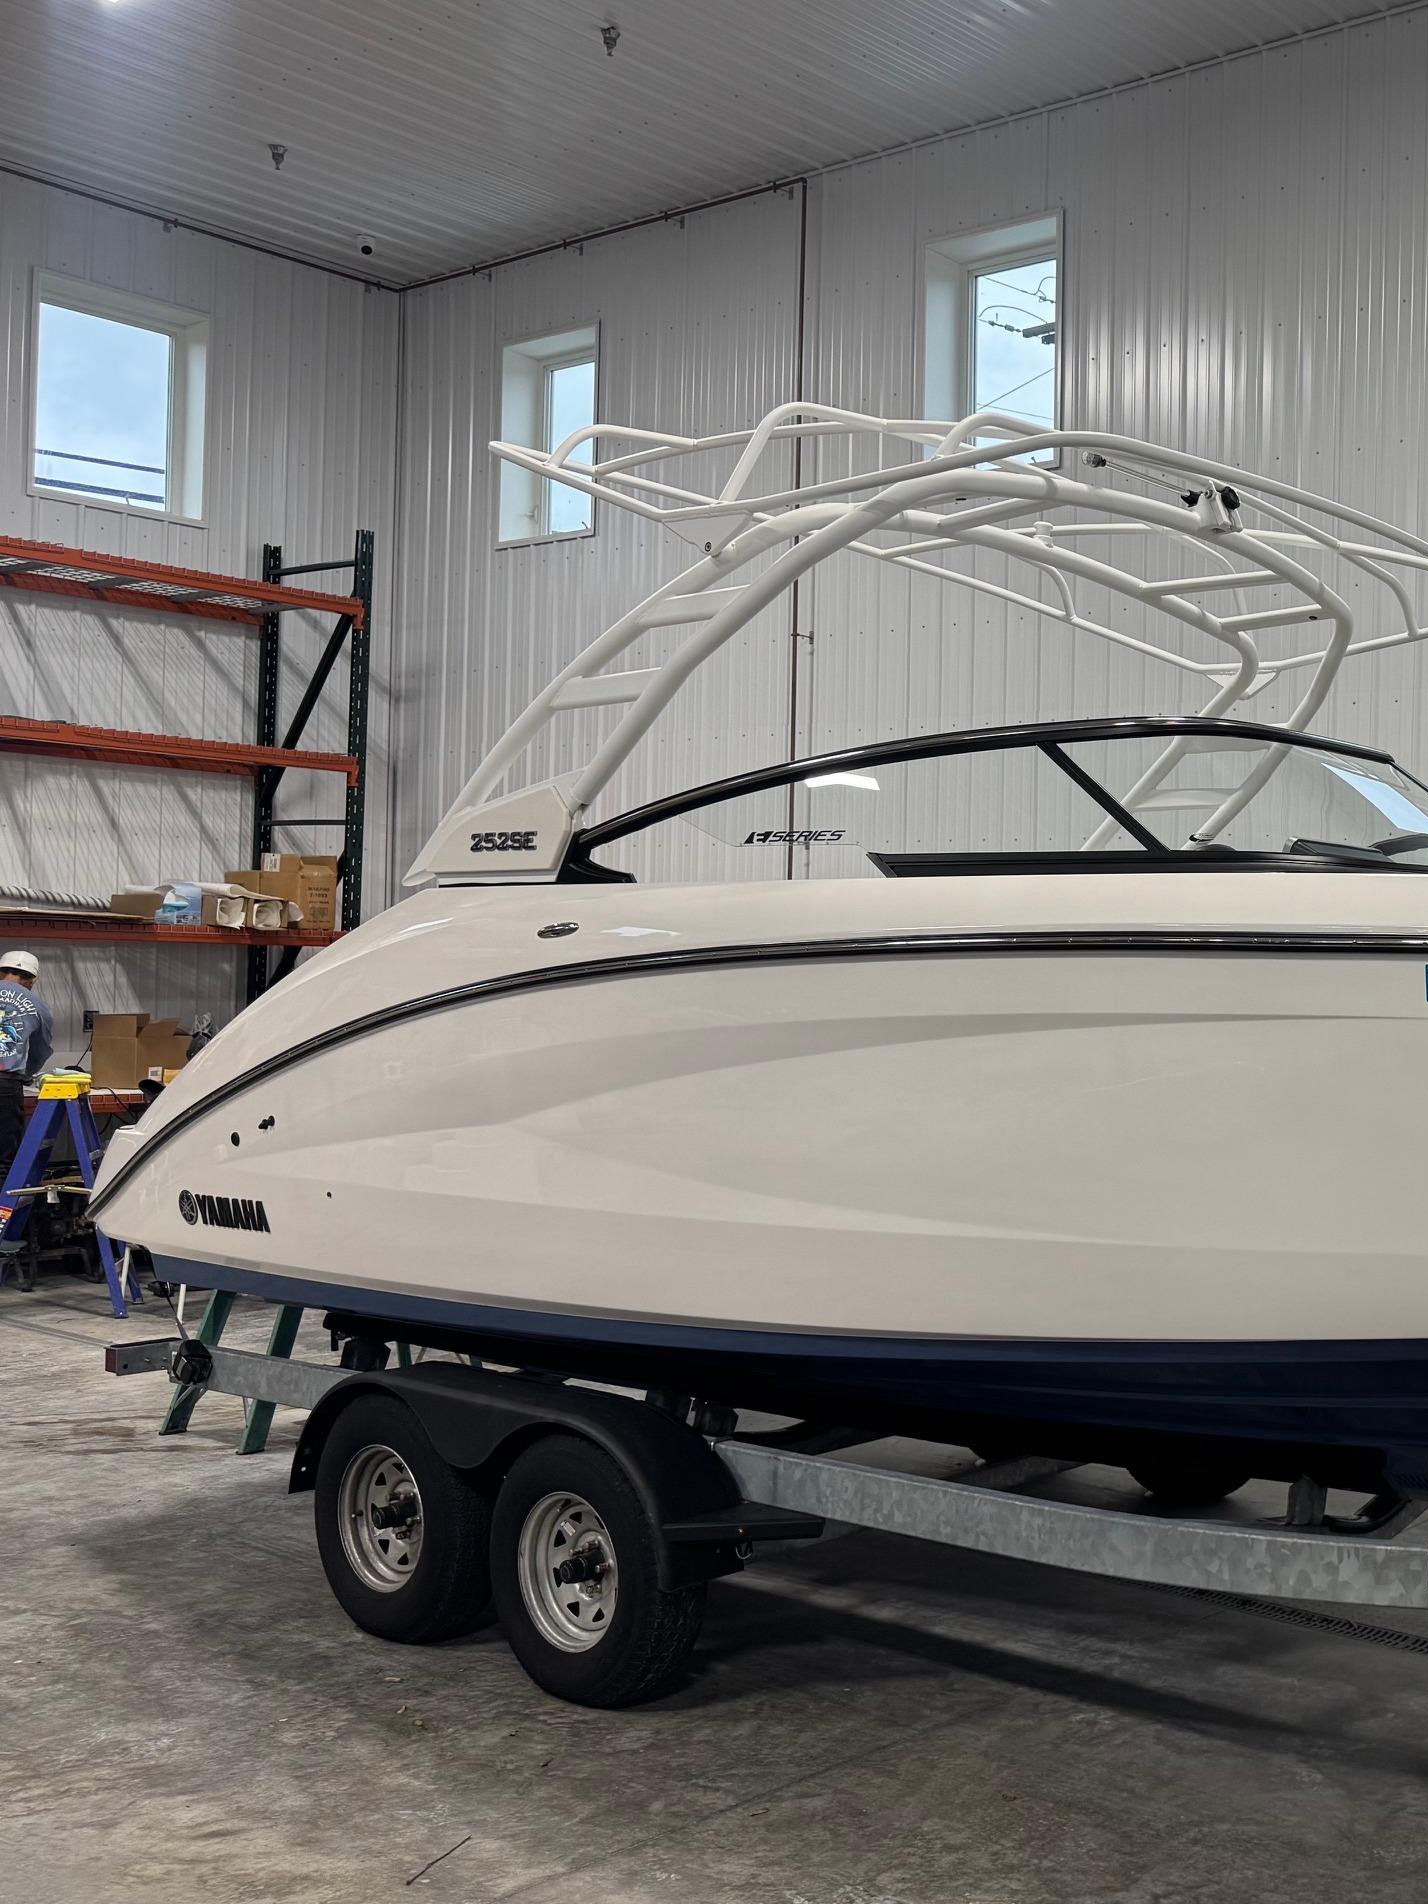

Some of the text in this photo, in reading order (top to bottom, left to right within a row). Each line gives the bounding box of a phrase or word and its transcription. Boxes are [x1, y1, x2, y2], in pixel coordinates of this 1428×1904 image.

[470, 831, 538, 852] 252SE
[768, 830, 846, 842] SERIES
[16, 992, 38, 1017] LIGHT
[194, 1193, 271, 1233] YAMAHA
